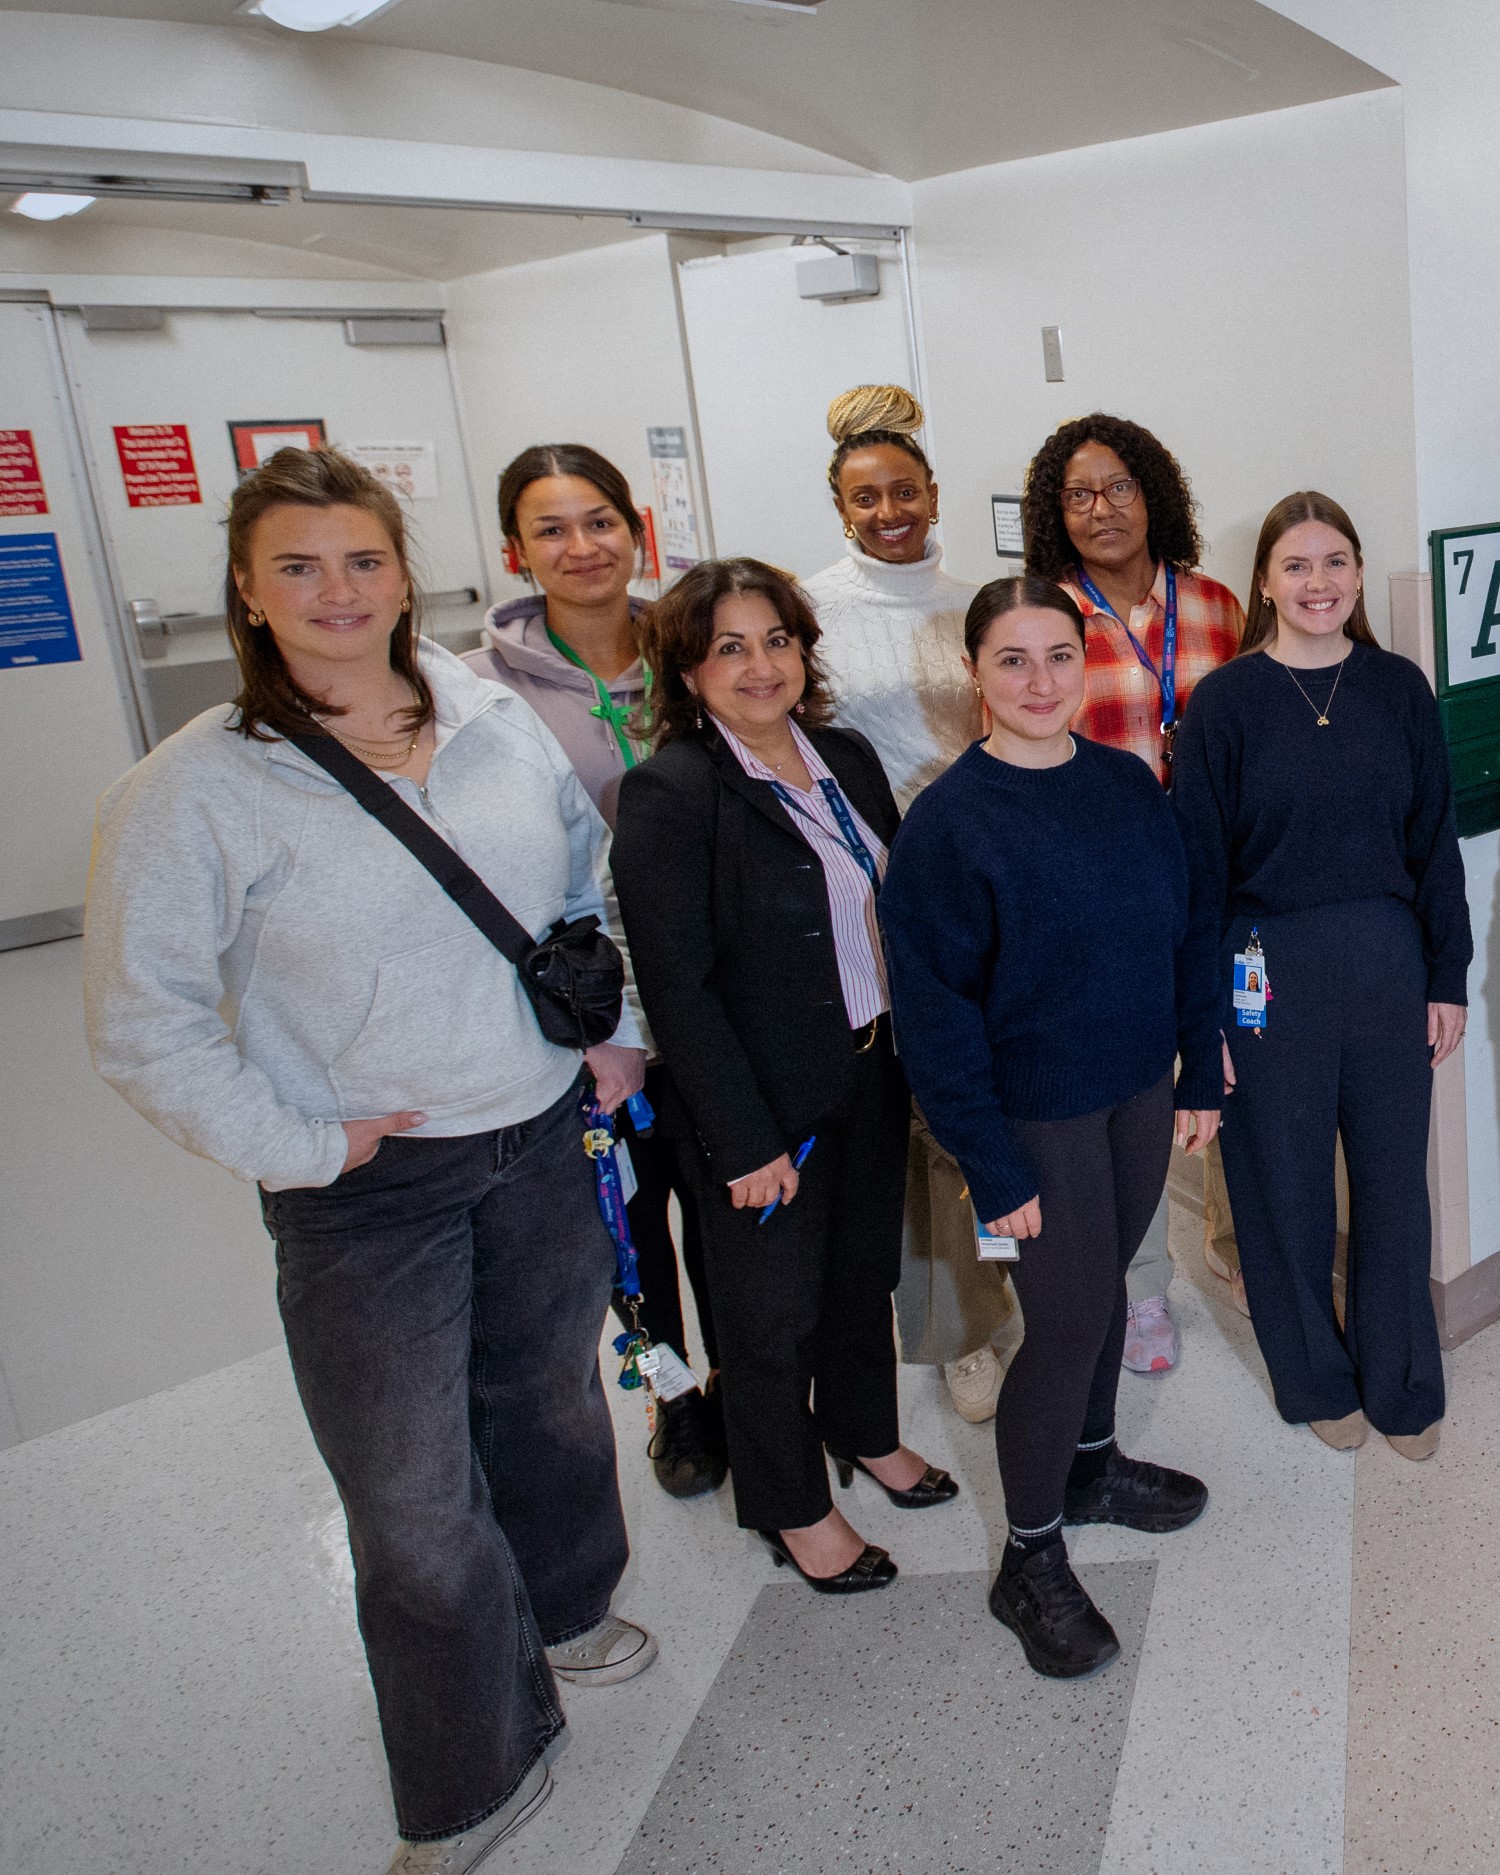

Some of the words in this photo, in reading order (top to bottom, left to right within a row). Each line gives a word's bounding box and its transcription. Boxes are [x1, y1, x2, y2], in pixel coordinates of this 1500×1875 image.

[1453, 549, 1474, 595] 7
[1241, 1009, 1261, 1018] Safety
[1242, 1017, 1261, 1025] Coach
